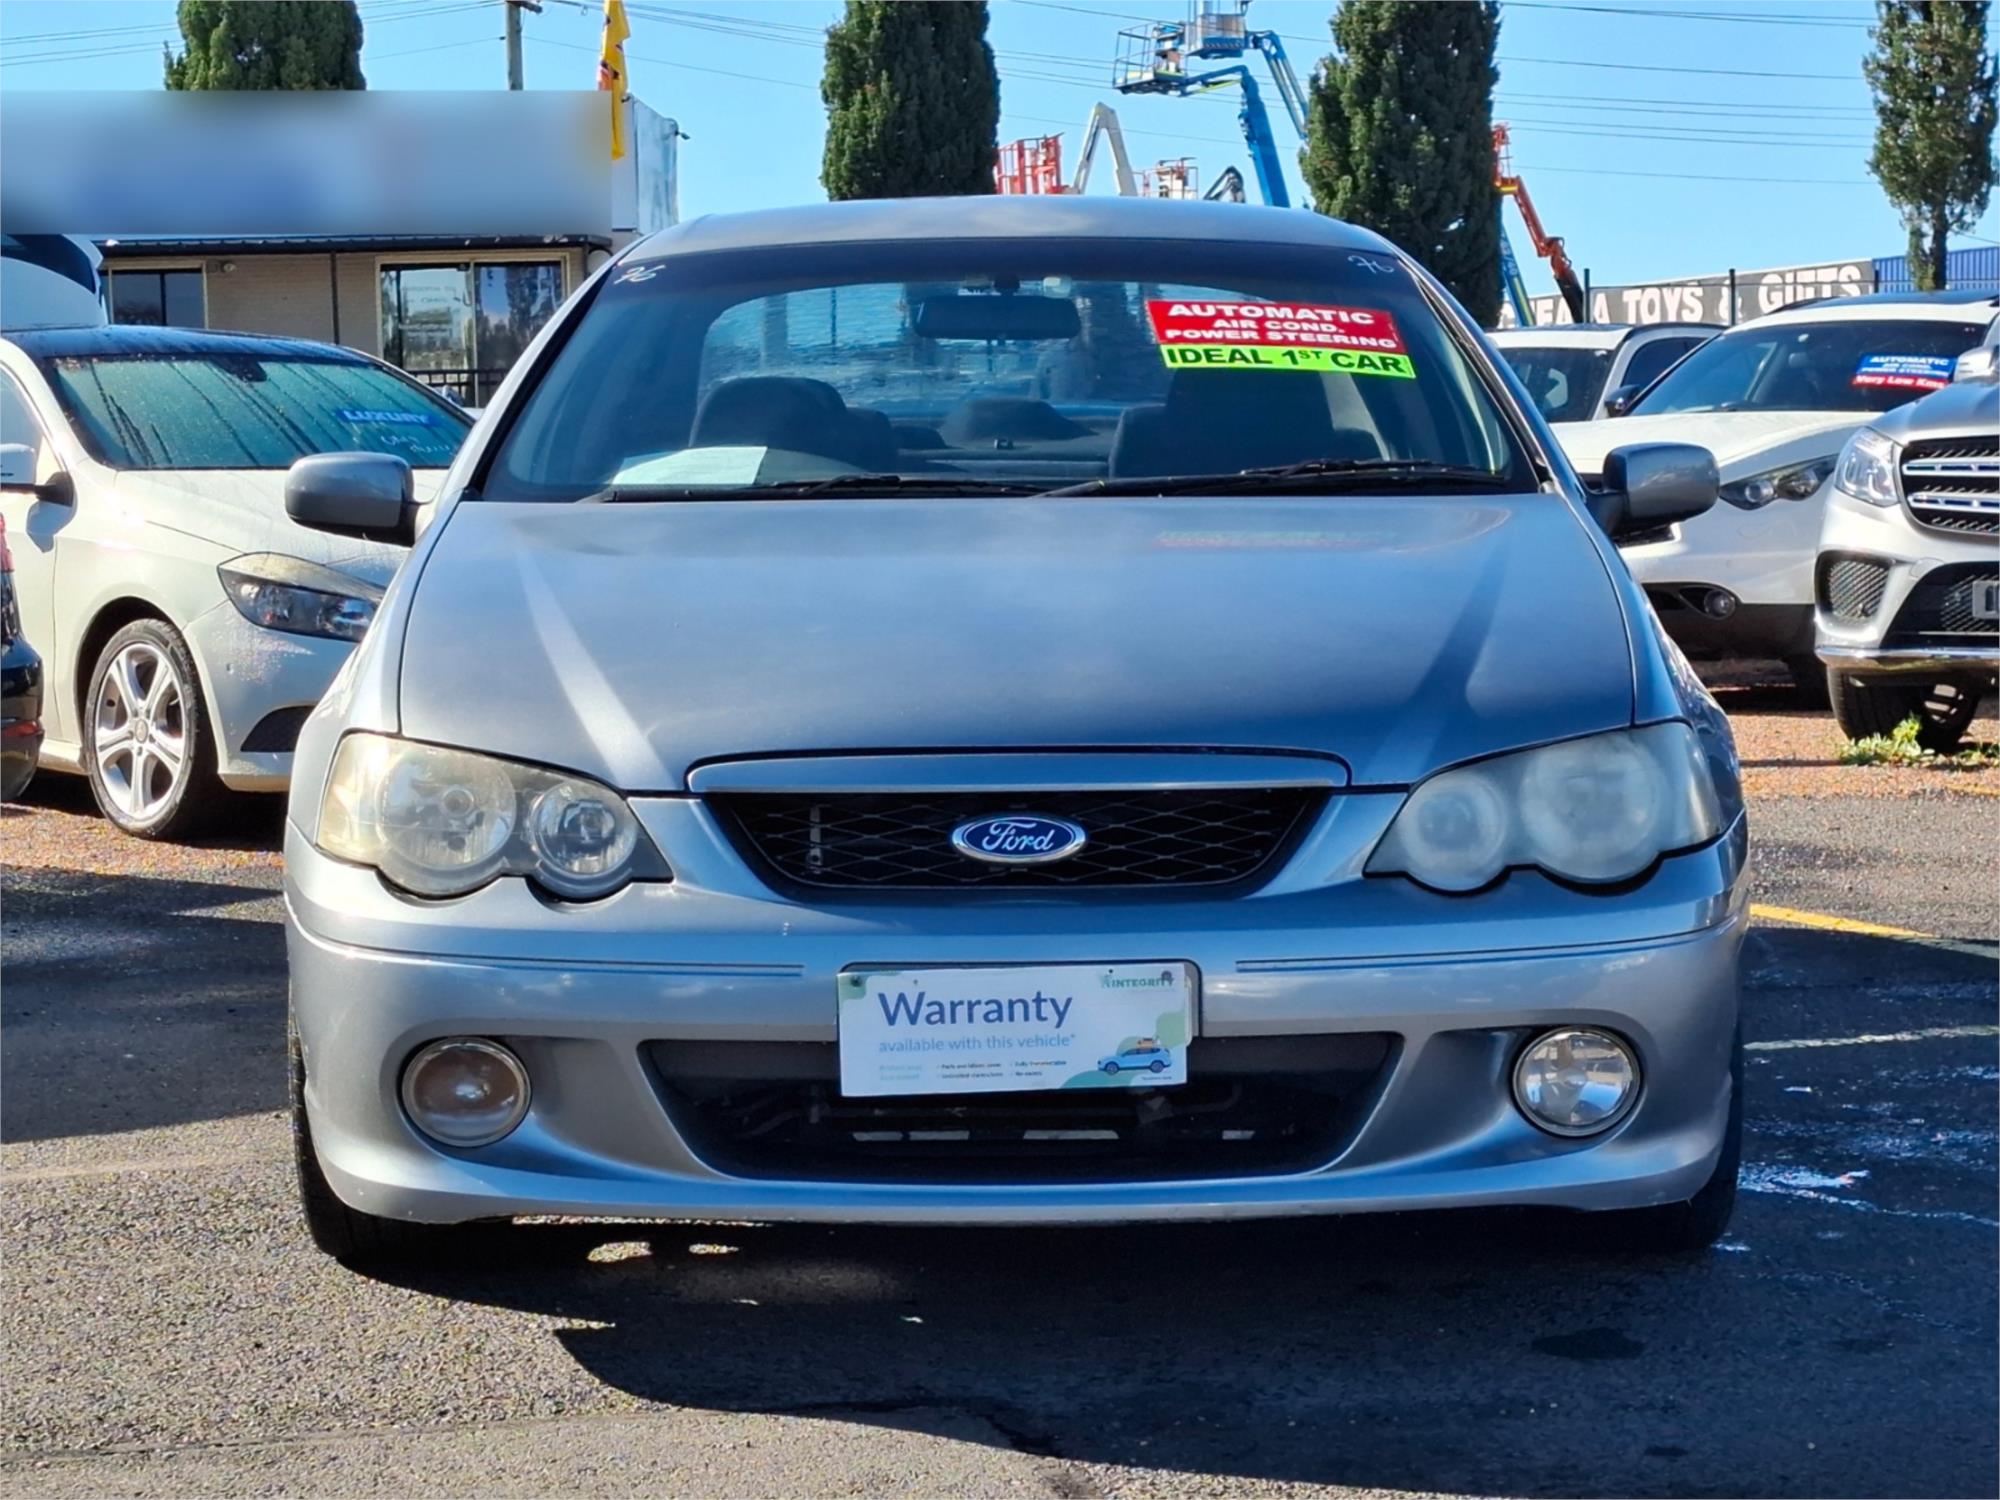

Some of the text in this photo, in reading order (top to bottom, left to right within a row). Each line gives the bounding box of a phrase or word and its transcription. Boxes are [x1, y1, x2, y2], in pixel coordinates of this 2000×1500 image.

[1622, 281, 1703, 325] TOYS
[1758, 265, 1862, 314] GIFTS
[1168, 303, 1375, 325] AUTOMATIC
[1213, 318, 1346, 333] AIR COND.
[1165, 329, 1397, 349] POWER STEERING
[1167, 348, 1273, 364] IDEAL
[1331, 352, 1407, 374] CAR
[1869, 356, 1950, 366] AUTOMATIC
[1855, 374, 1886, 385] Very
[1887, 375, 1915, 386] Low
[981, 822, 1054, 851] Ford
[878, 990, 1073, 1029] Warranty
[879, 1036, 945, 1053] available
[948, 1034, 982, 1050] with
[986, 1034, 1013, 1049] this
